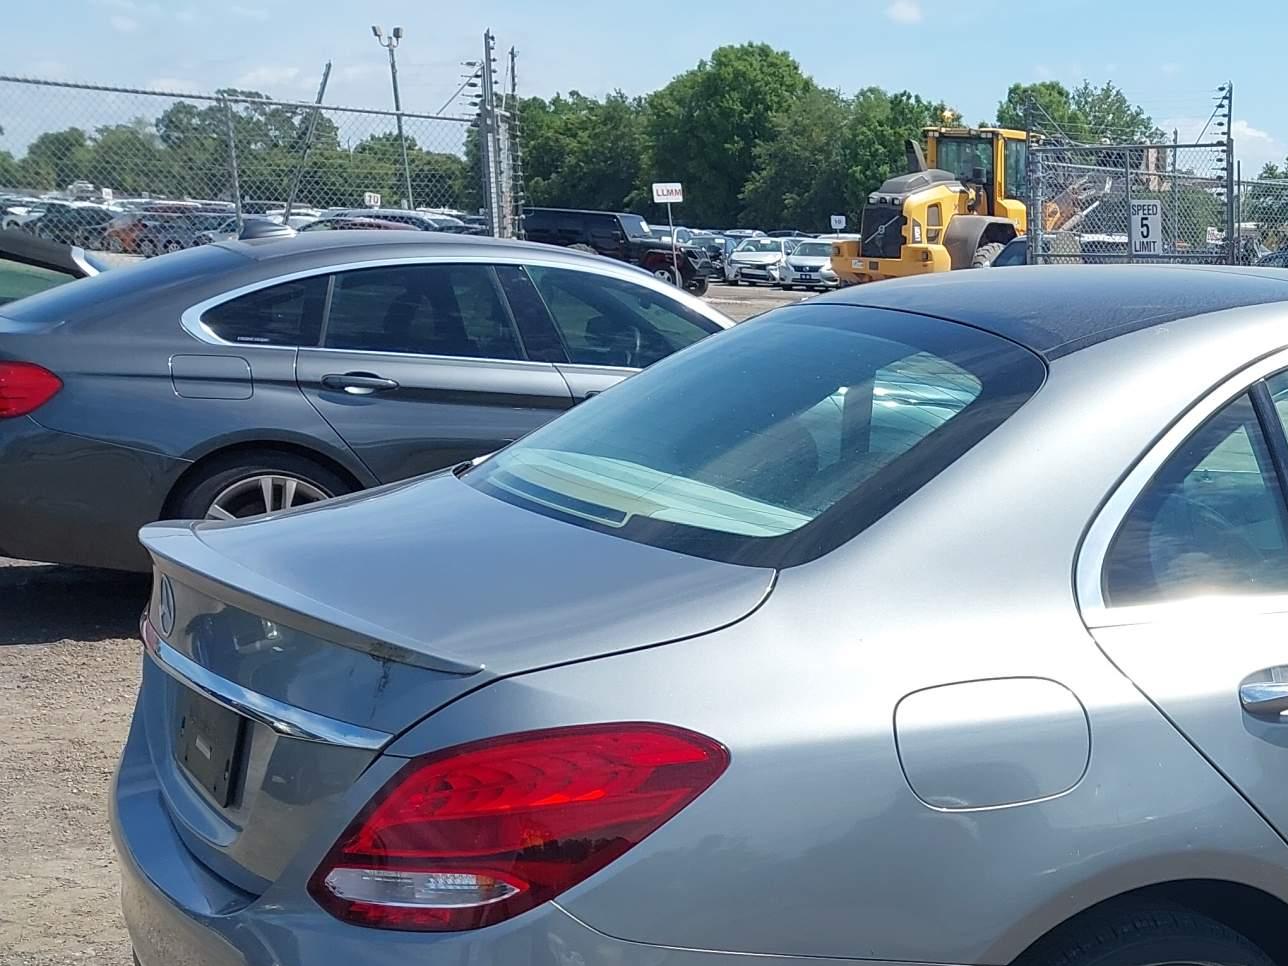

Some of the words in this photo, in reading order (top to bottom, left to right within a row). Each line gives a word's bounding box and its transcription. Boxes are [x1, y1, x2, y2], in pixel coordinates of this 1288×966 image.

[1131, 204, 1158, 216] SPEED
[1140, 216, 1150, 239] 5
[1134, 240, 1157, 253] LIMIT
